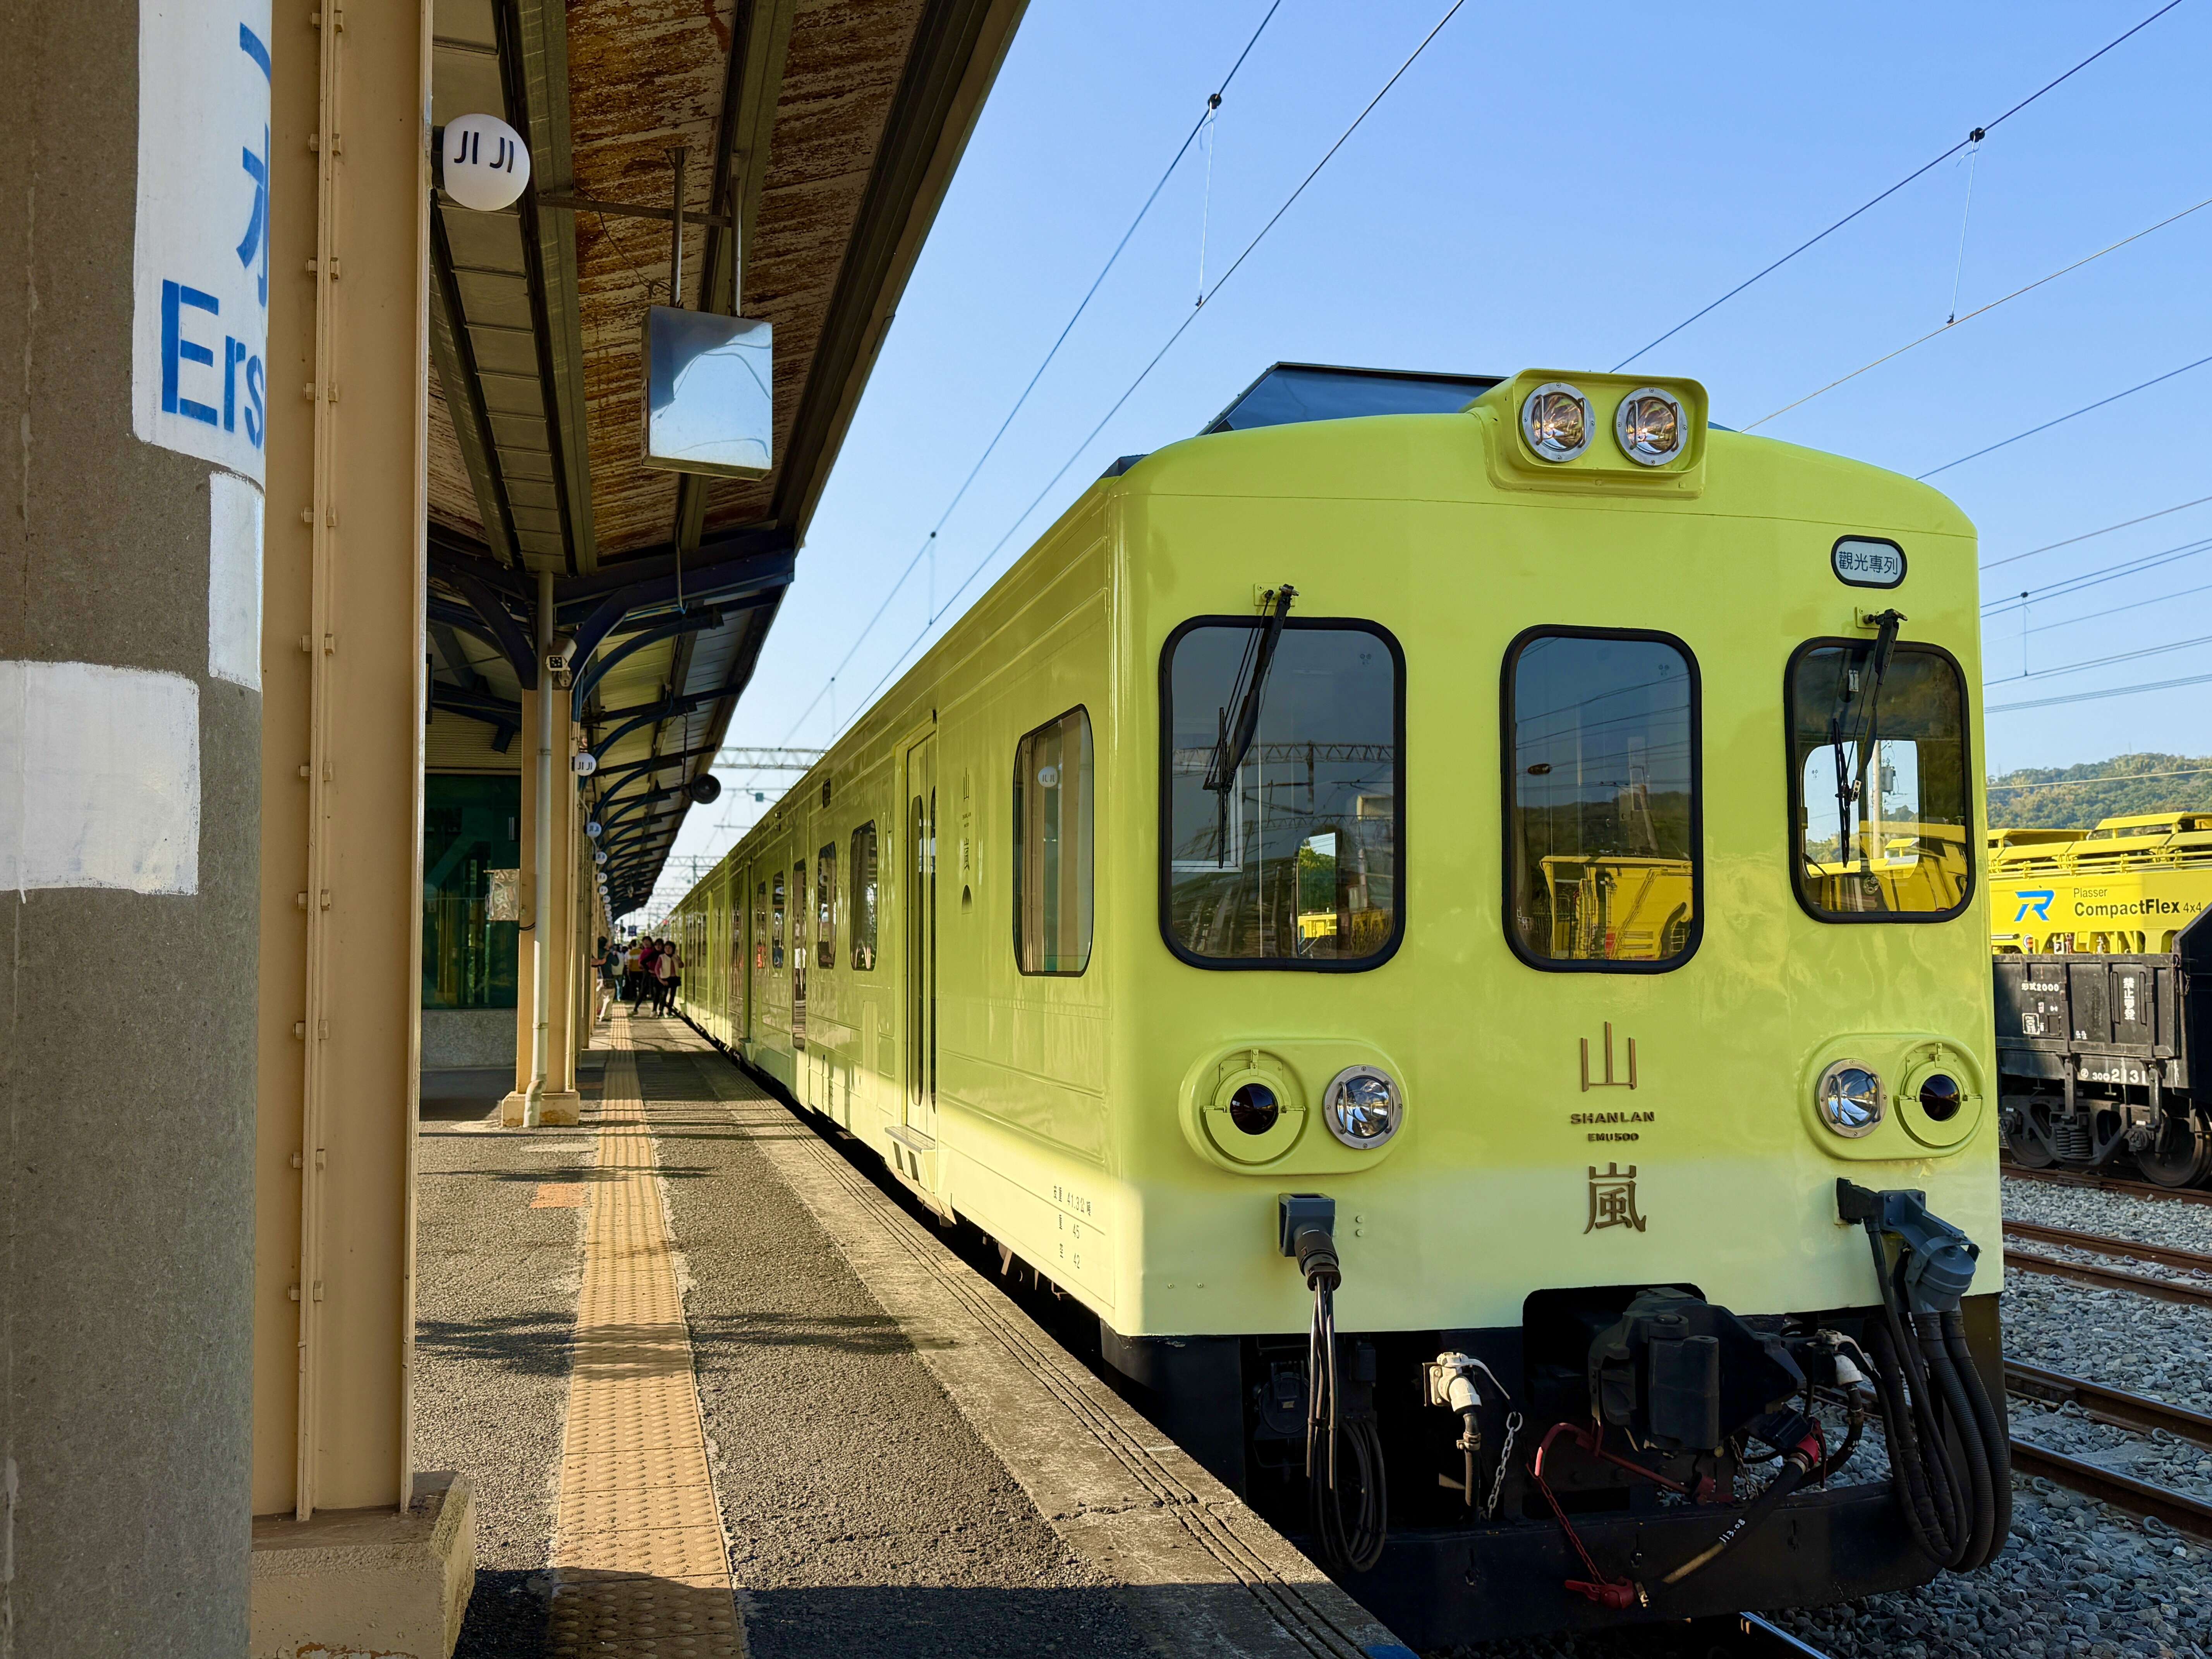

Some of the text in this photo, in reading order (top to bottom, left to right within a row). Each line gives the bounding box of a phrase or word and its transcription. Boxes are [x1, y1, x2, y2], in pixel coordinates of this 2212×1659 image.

[454, 131, 514, 173] JI JI
[1839, 551, 1898, 575] 觀光專列
[577, 762, 592, 770] JI JI
[2074, 888, 2108, 898] Plasser
[2074, 898, 2202, 918] CompactFlex 4x4
[1580, 1021, 1637, 1092] 山
[1571, 1111, 1655, 1125] SHANLAN
[1588, 1132, 1639, 1142] EMU500
[1583, 1162, 1647, 1234] 嵐
[1073, 1223, 1080, 1239] 45
[1073, 1253, 1080, 1269] 42
